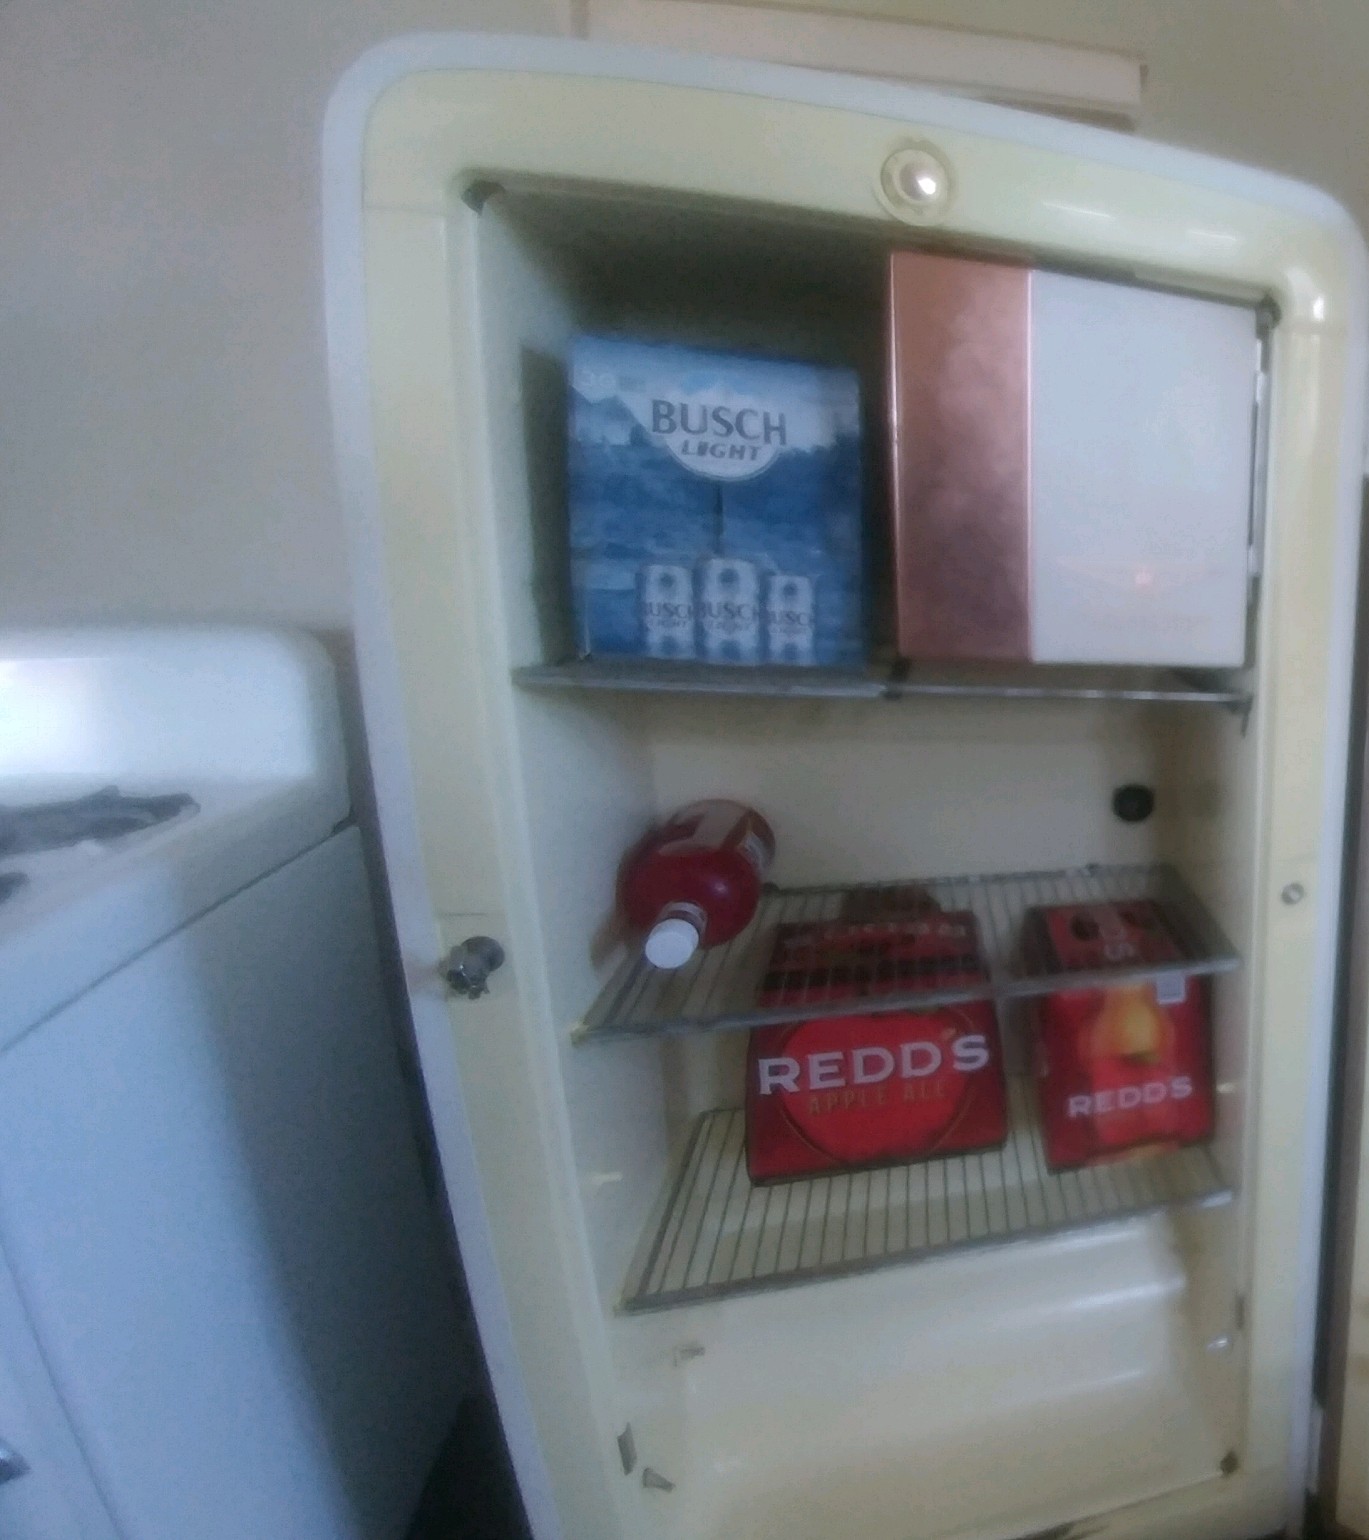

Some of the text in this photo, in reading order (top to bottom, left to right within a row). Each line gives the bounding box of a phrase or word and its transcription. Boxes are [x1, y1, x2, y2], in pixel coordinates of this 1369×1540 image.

[652, 399, 787, 447] BUSCH
[681, 440, 761, 462] LIGHT
[807, 1085, 891, 1115] APPLE
